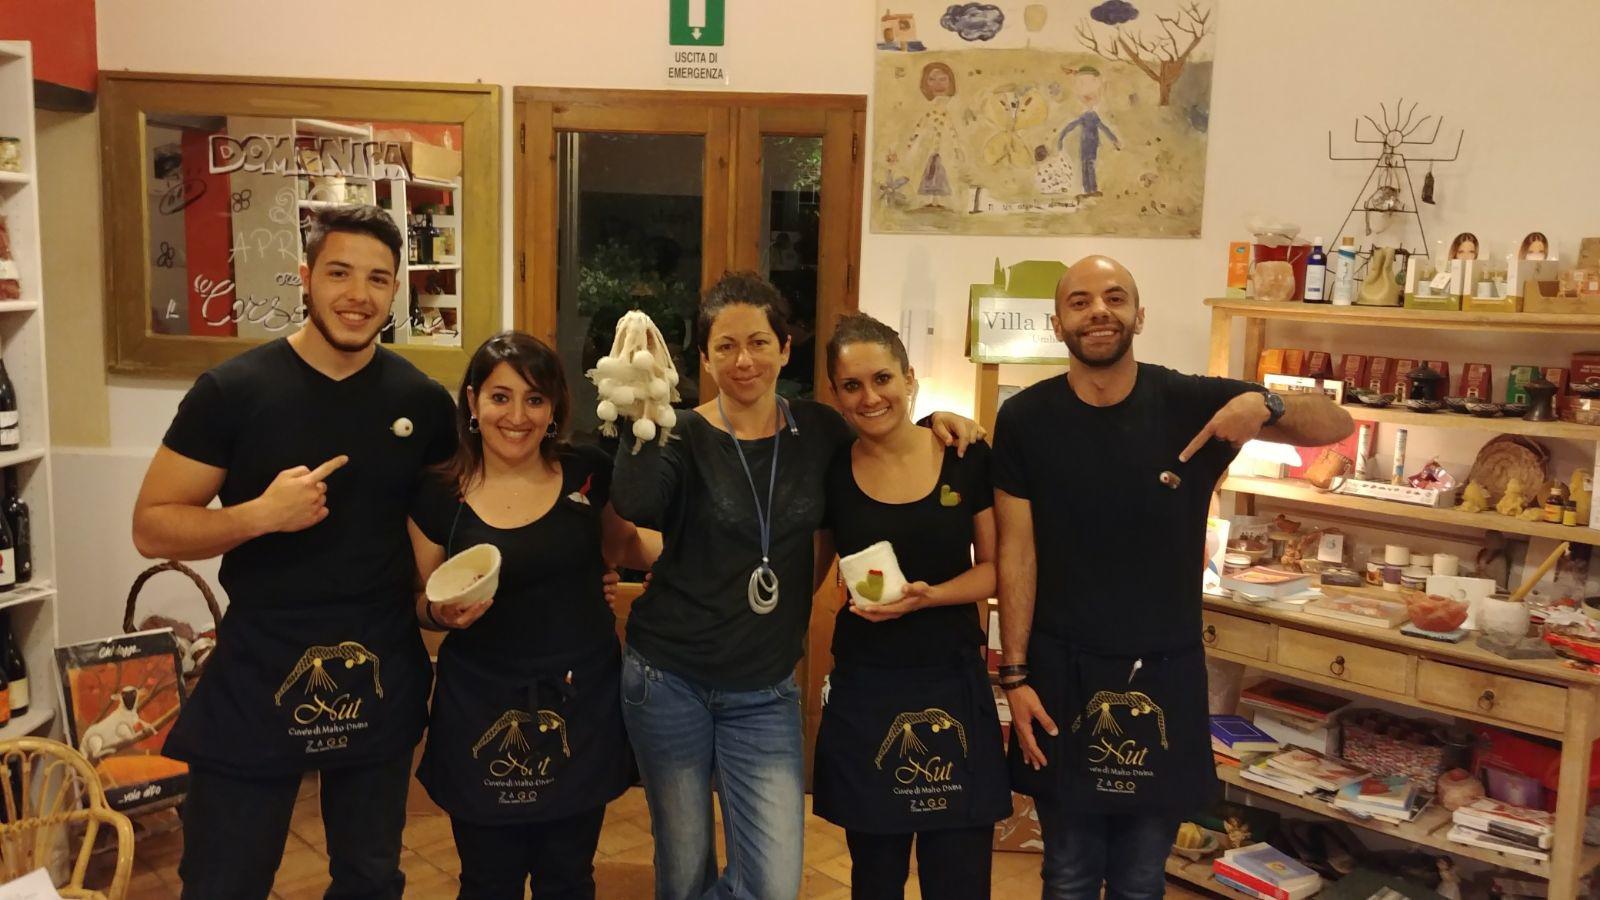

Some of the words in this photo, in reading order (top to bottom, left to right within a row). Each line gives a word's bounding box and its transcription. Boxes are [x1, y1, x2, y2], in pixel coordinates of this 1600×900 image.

[675, 52, 706, 63] USCITA
[709, 53, 718, 63] DI
[668, 67, 724, 79] EMERGENZA
[983, 311, 1035, 331] Villa
[1096, 777, 1137, 791] ZAGO
